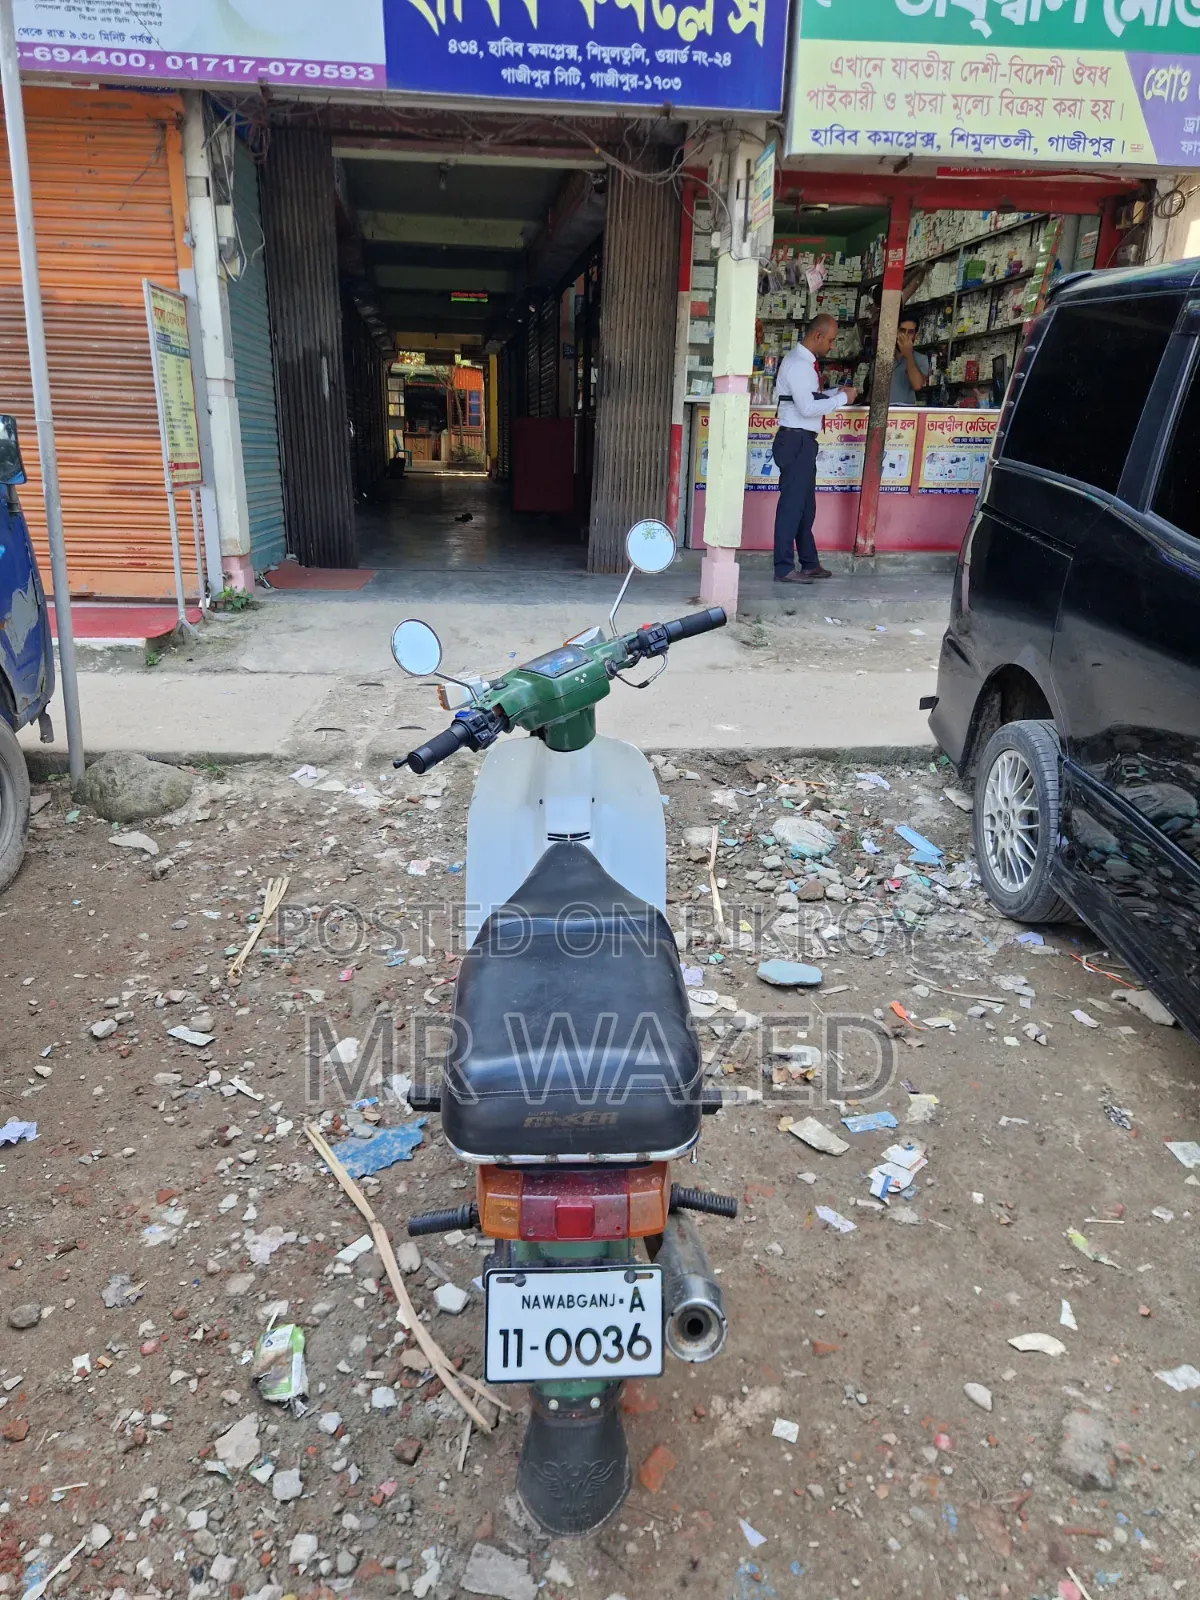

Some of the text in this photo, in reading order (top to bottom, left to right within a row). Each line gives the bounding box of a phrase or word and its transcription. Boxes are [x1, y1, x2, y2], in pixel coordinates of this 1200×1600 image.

[47, 29, 65, 39] রাত
[99, 31, 127, 45] মিনিট
[448, 38, 484, 59] ৪৩৪,
[487, 37, 524, 58] হাবিব
[17, 46, 375, 81] -694400, 01717-079593
[501, 64, 551, 89] গাজীপুর
[553, 66, 586, 89] সিটি,
[830, 54, 886, 79] এখানে
[961, 53, 1065, 86] দেশী-বিদেশী
[1072, 57, 1111, 87] ঔষধ
[807, 82, 877, 112] পাইকারী
[884, 92, 896, 111] ও
[905, 91, 946, 119] খুচরা
[952, 94, 993, 122] মূল্যে
[1052, 96, 1085, 120] করা
[810, 123, 861, 148] হাবিব
[950, 127, 1038, 155] শিমুলতলী,
[499, 1322, 652, 1367] 11-0036
